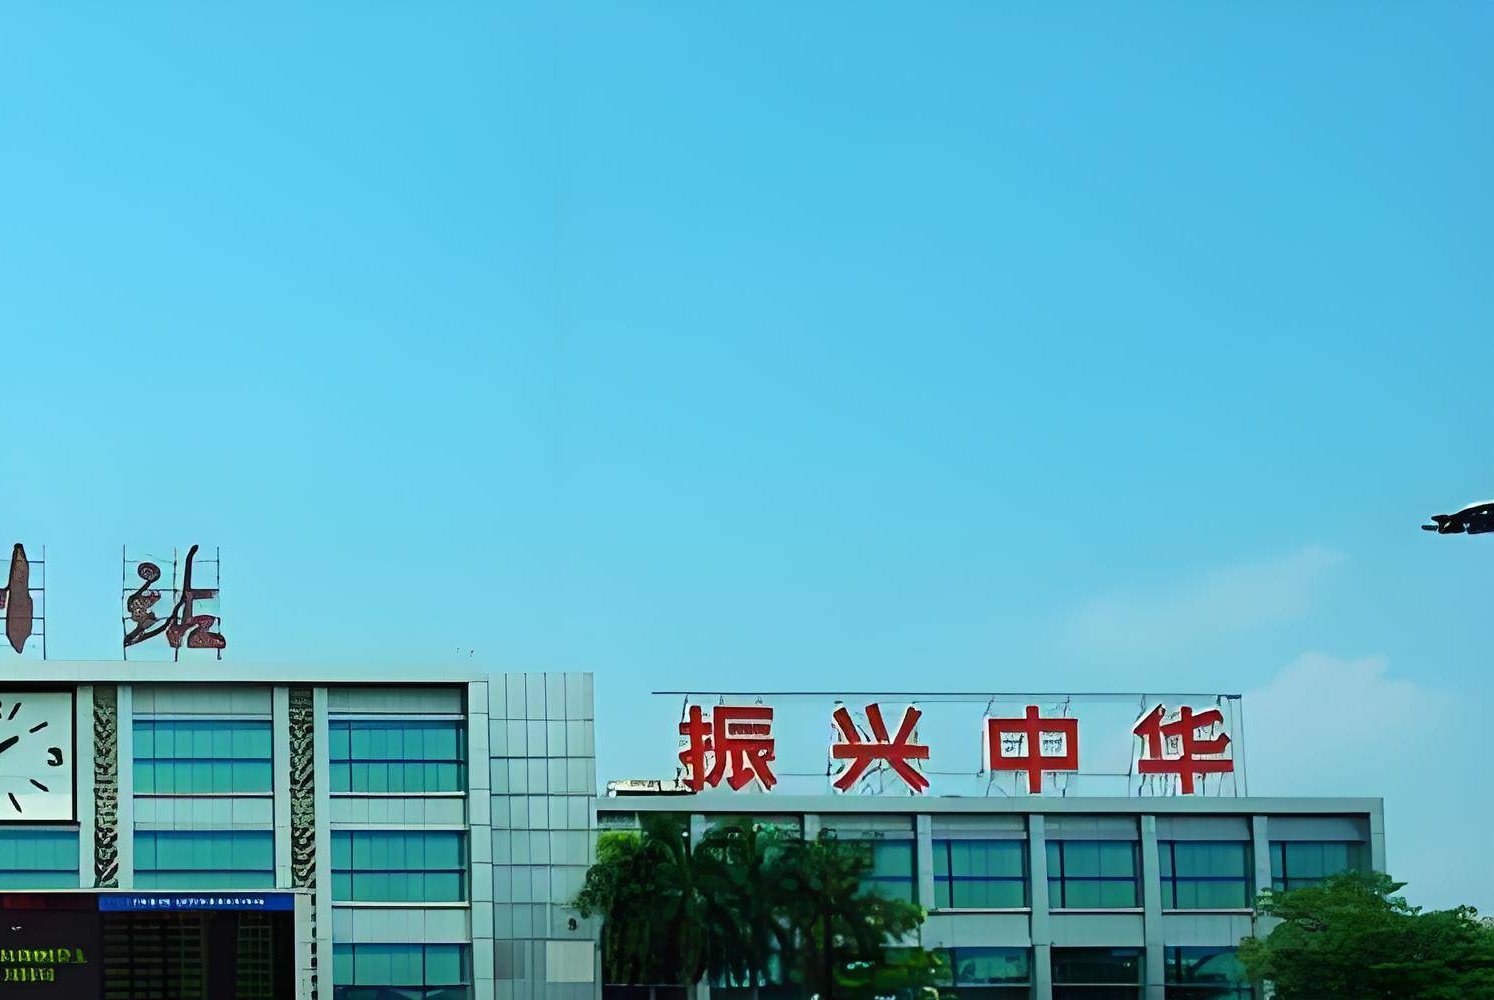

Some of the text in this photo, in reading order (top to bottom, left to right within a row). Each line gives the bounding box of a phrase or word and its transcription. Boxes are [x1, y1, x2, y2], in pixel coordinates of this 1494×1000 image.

[47, 747, 64, 767] 3
[679, 704, 1234, 794] 振兴中华
